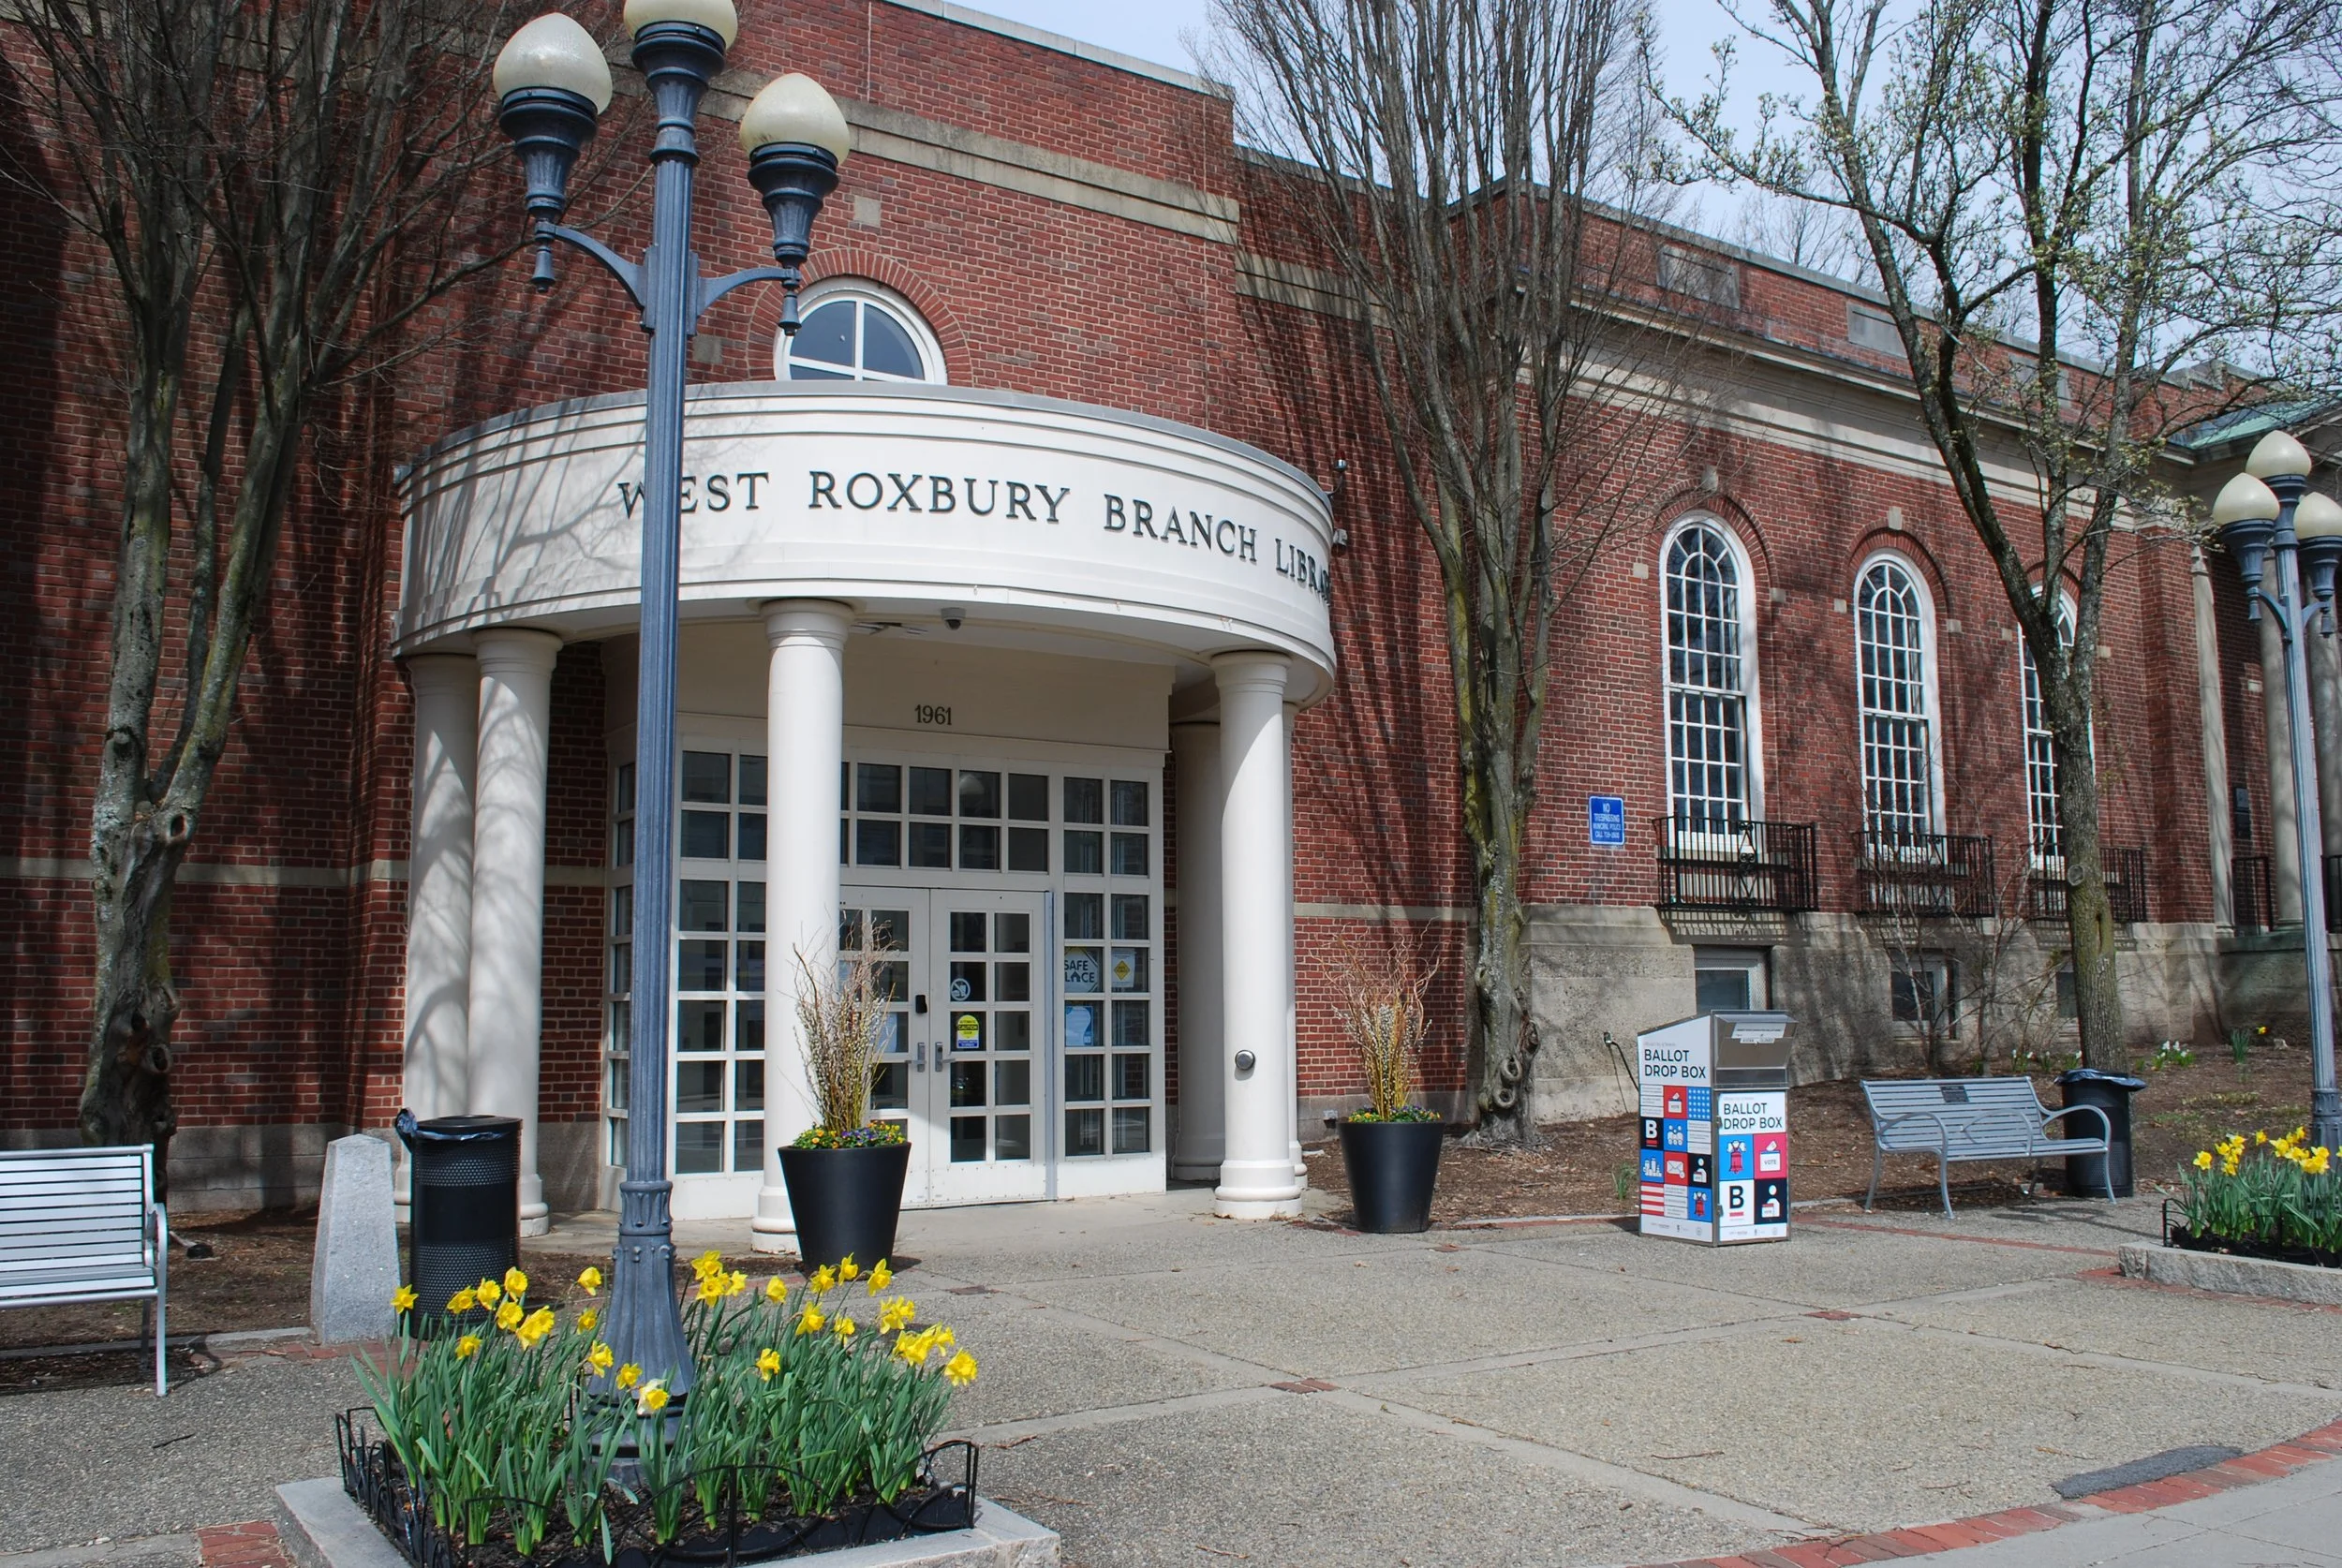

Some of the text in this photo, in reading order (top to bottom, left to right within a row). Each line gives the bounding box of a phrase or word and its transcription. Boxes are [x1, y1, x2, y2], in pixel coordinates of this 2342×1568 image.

[808, 470, 1070, 523] ROXBURY
[1104, 494, 1259, 563] BRANCH
[914, 704, 952, 725] 1961
[1602, 803, 1610, 813] NO
[1064, 960, 1089, 970] SAFE
[1644, 1049, 1689, 1061] BALLOT
[1644, 1065, 1706, 1078] DROP BOX
[1724, 1102, 1767, 1115] BALLOT
[1645, 1119, 1657, 1138] B
[1724, 1117, 1783, 1130] DROP BOX
[1729, 1186, 1744, 1209] B
